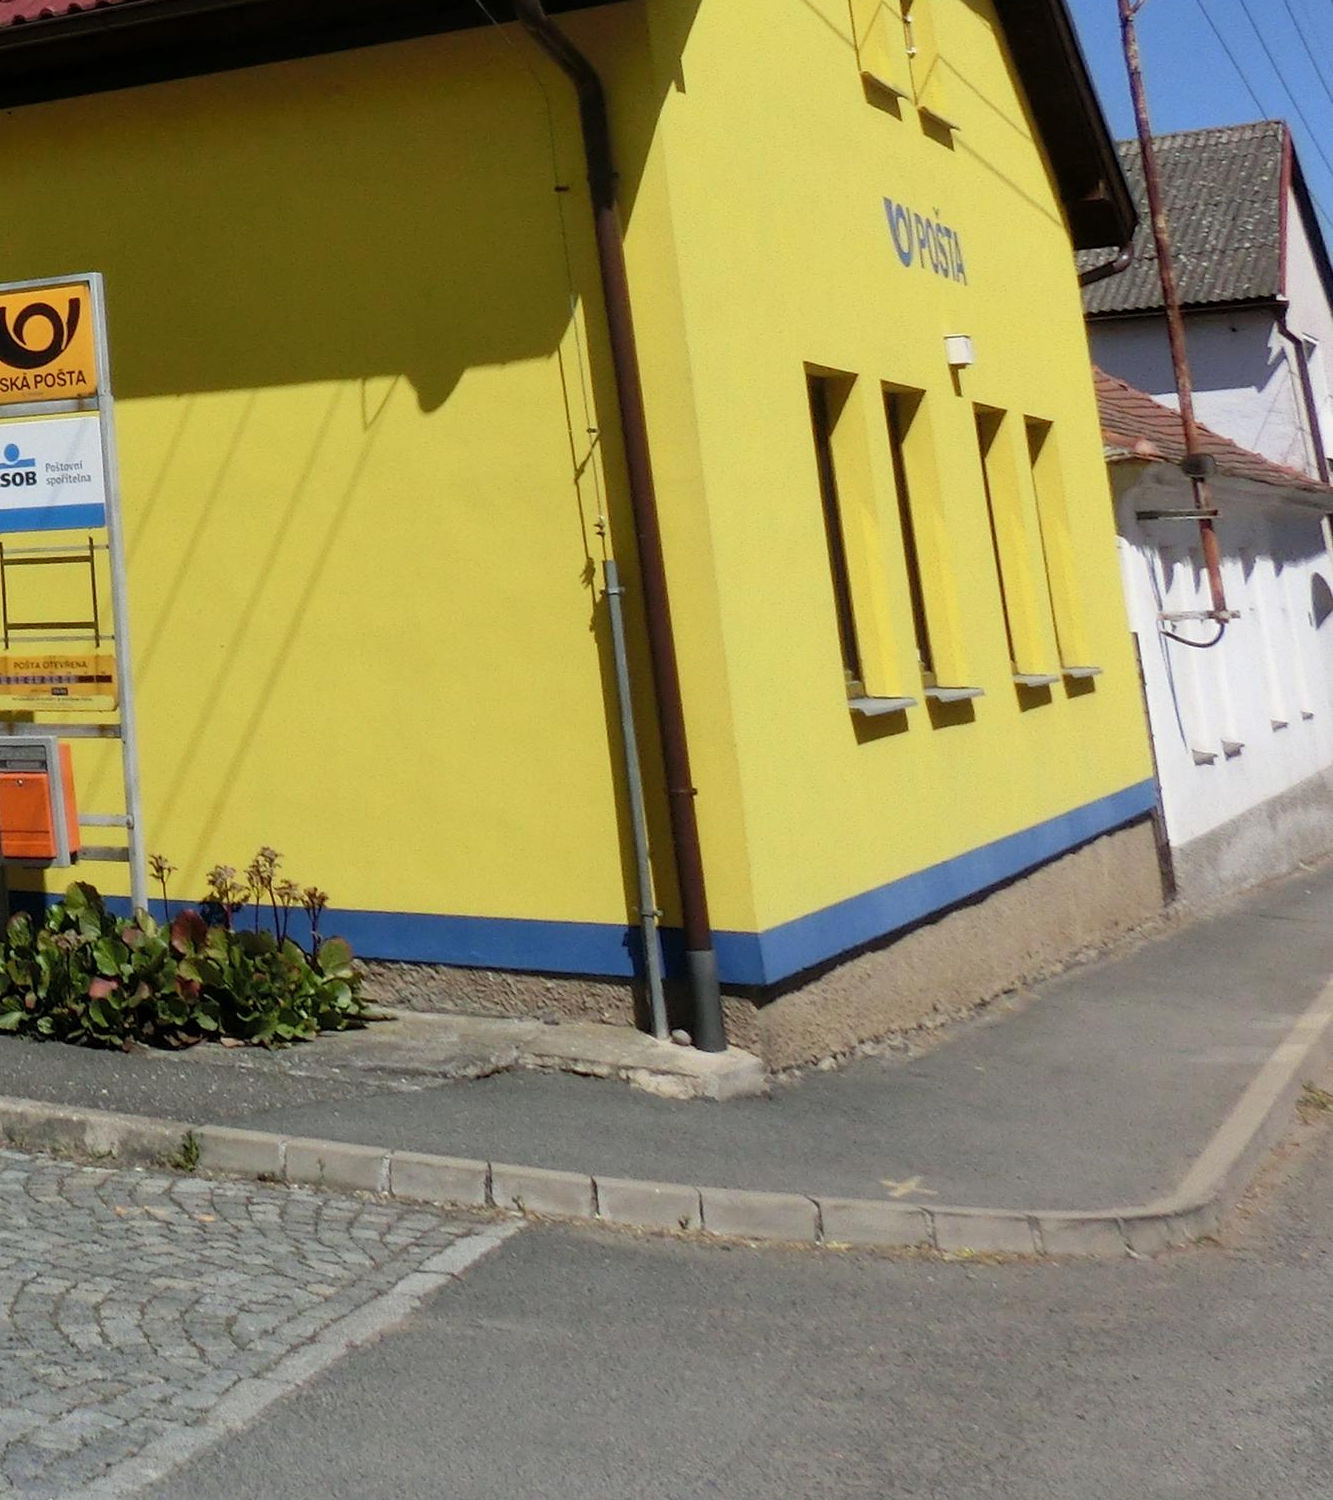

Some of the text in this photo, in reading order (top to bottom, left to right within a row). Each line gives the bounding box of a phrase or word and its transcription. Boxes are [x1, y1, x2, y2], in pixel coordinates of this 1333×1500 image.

[913, 205, 968, 286] POŠTA
[34, 369, 87, 389] POŠTA
[45, 460, 83, 472] Poštovní
[45, 473, 92, 487] spořitelna
[14, 660, 41, 670] POŠTA
